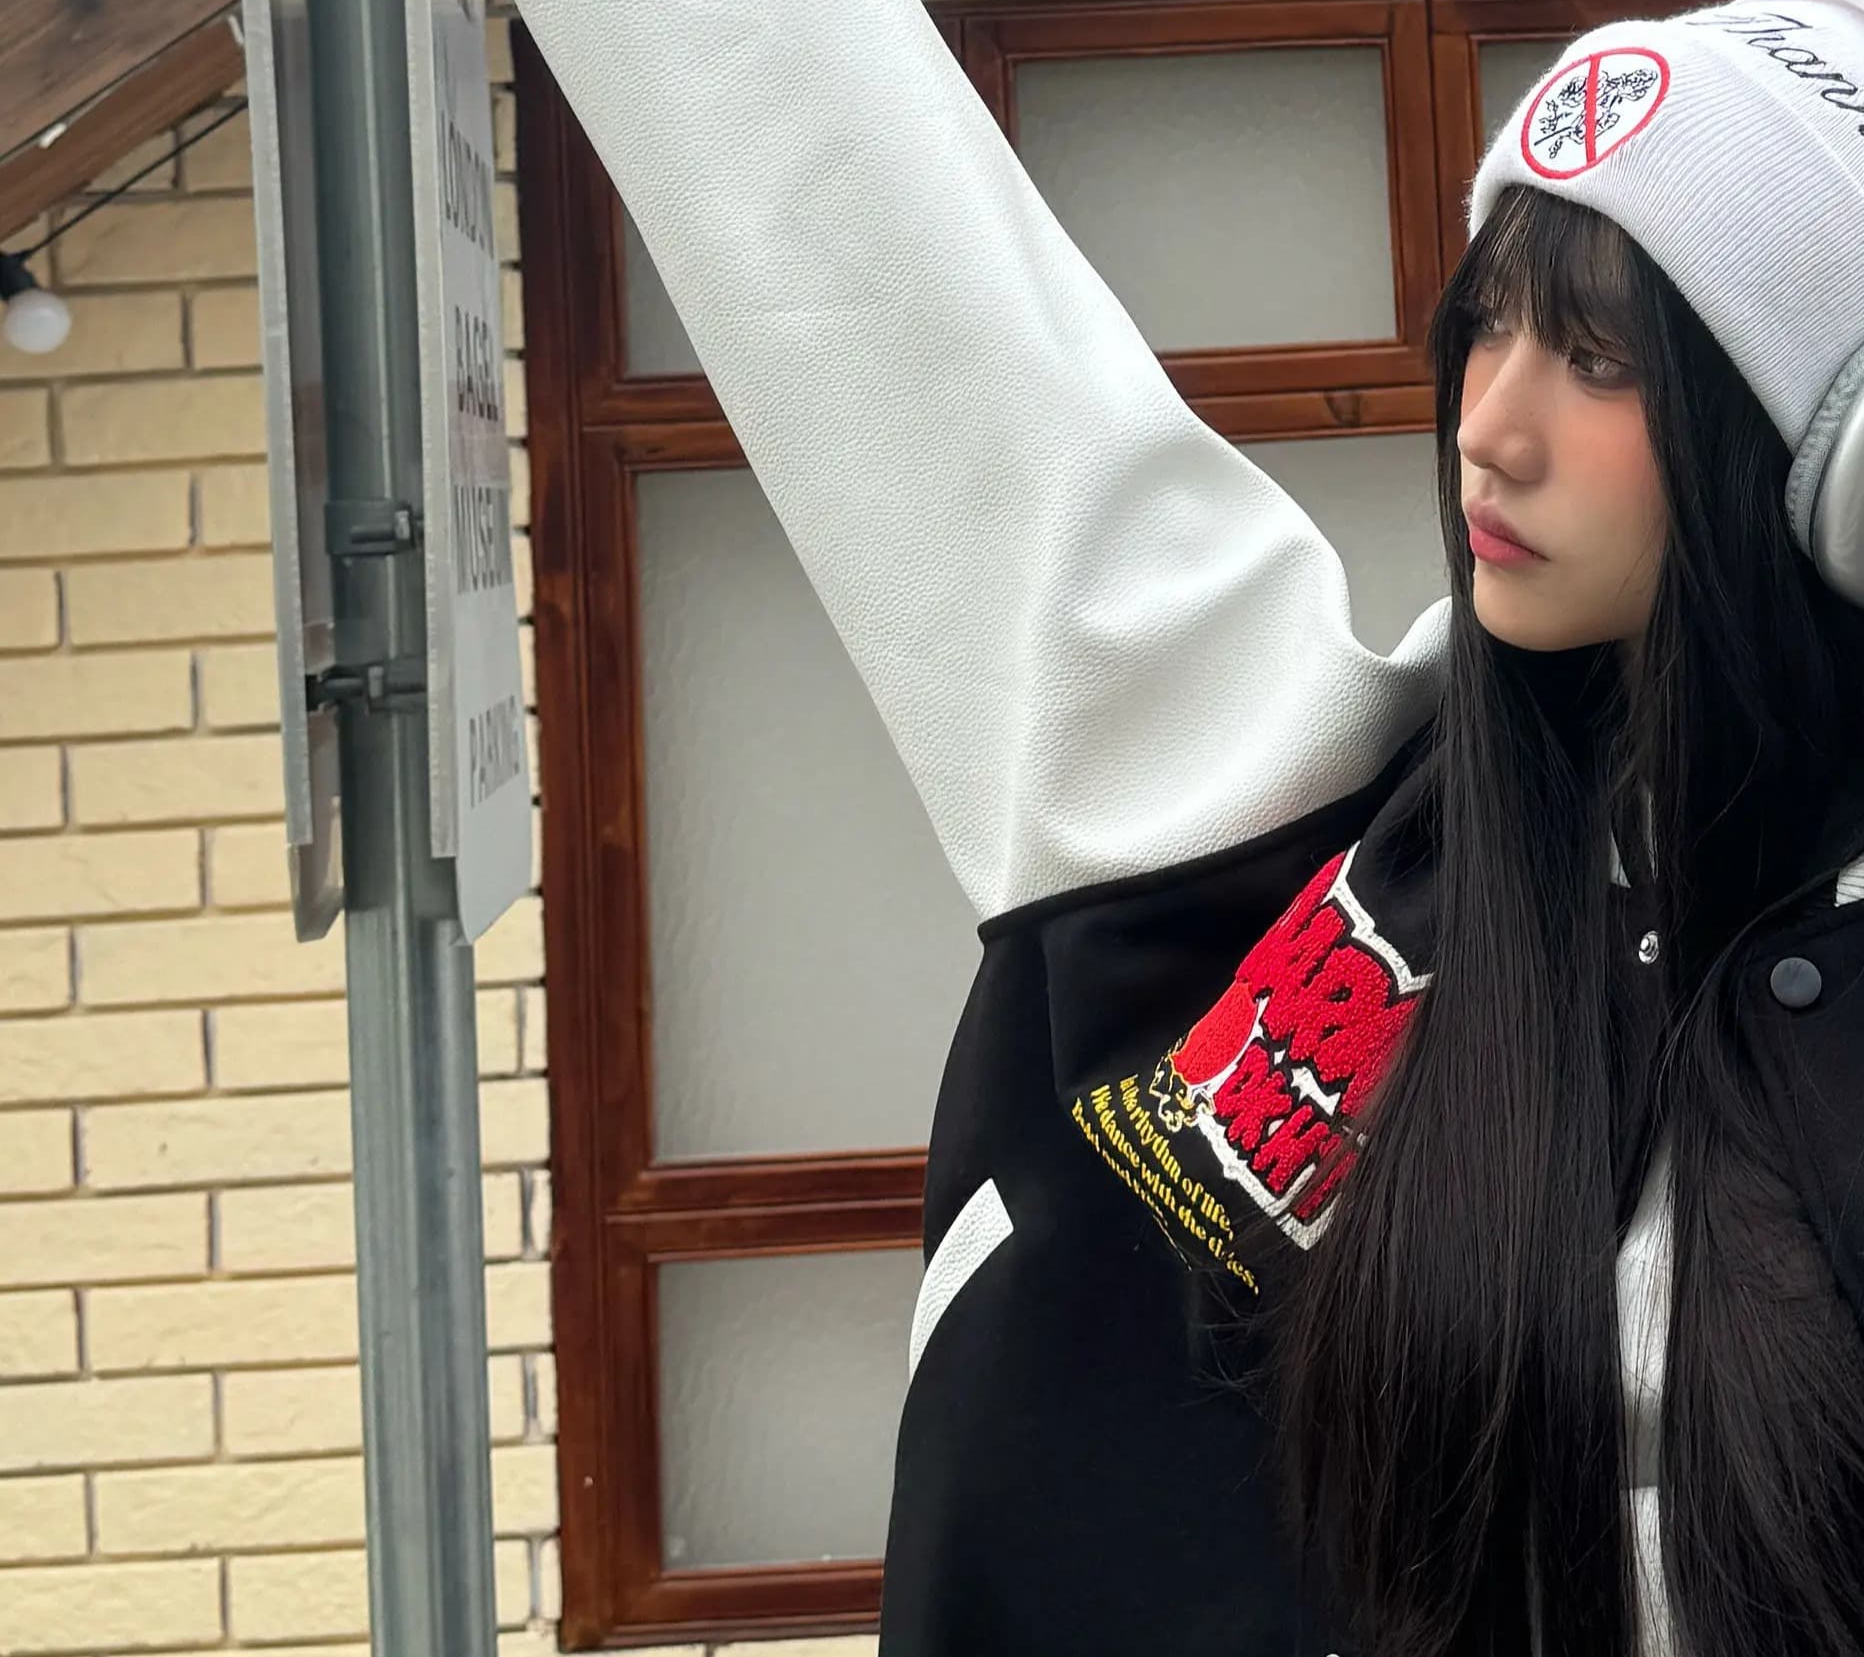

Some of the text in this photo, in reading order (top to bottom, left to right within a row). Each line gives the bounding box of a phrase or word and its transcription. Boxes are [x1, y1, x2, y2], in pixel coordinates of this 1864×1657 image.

[455, 305, 499, 423] BAGEL
[469, 695, 520, 810] PARKING
[1099, 1109, 1140, 1168] dance
[1140, 1162, 1176, 1213] with
[1178, 1205, 1206, 1240] the
[1129, 1106, 1182, 1183] rhythm
[1182, 1177, 1204, 1203] of
[1201, 1193, 1233, 1240] life,
